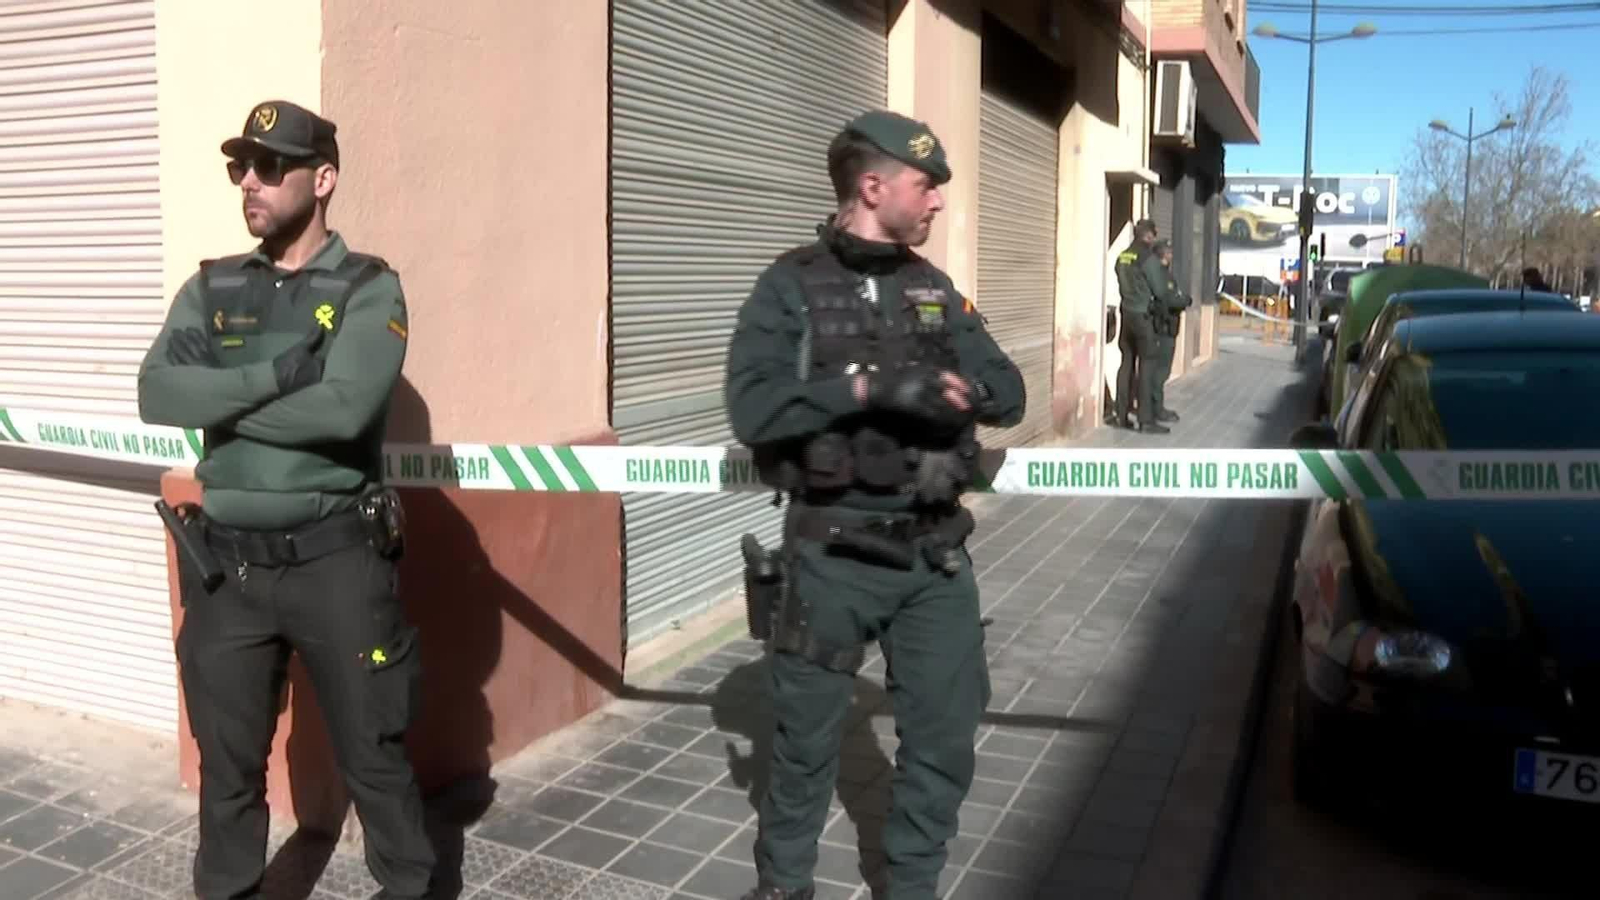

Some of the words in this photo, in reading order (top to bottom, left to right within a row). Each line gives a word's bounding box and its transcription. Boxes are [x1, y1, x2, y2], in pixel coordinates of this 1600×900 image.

[37, 422, 89, 447] GUARDIA
[90, 428, 120, 453] CIVIL
[123, 433, 141, 454] NO
[143, 435, 186, 460] PASAR
[401, 453, 424, 479] NO
[430, 454, 489, 480] PASAR
[626, 458, 711, 483] GUARDIA
[1027, 461, 1120, 489] GUARDIA
[1128, 462, 1181, 489] CIVIL
[1190, 463, 1218, 489] NO
[1227, 463, 1298, 490] PASAR
[1459, 461, 1561, 491] GUARDIA
[1546, 759, 1598, 794] 76
